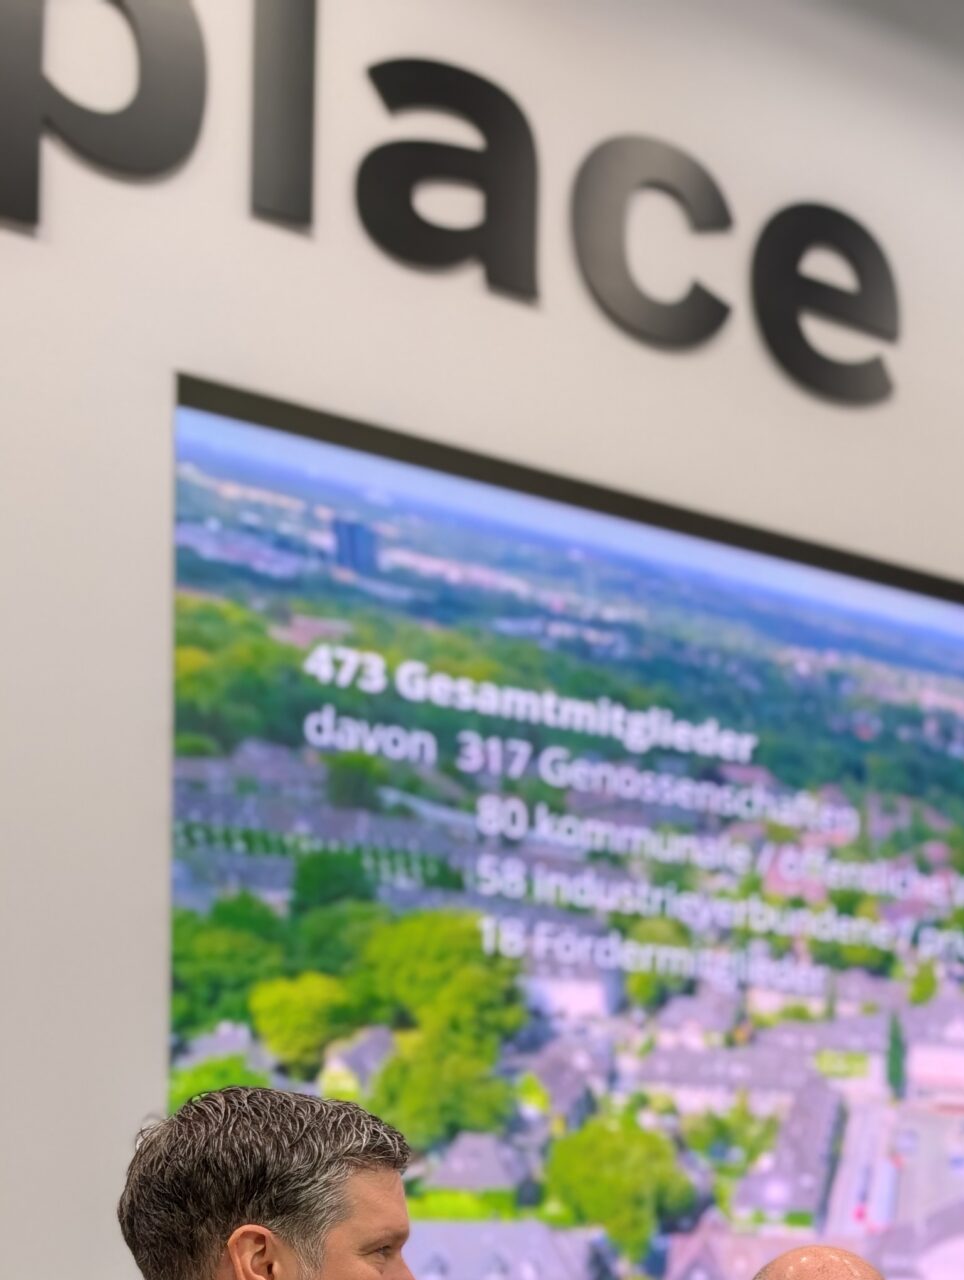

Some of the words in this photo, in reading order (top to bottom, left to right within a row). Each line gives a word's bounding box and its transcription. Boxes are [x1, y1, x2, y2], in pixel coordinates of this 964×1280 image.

[0, 0, 900, 408] place
[302, 643, 387, 695] 473
[394, 660, 758, 764] Gesamtmitglieder
[302, 705, 438, 767] davon
[455, 729, 534, 780] 317
[537, 746, 860, 841] Genossenschaften
[475, 794, 529, 839] 80
[533, 800, 753, 875] kommunale
